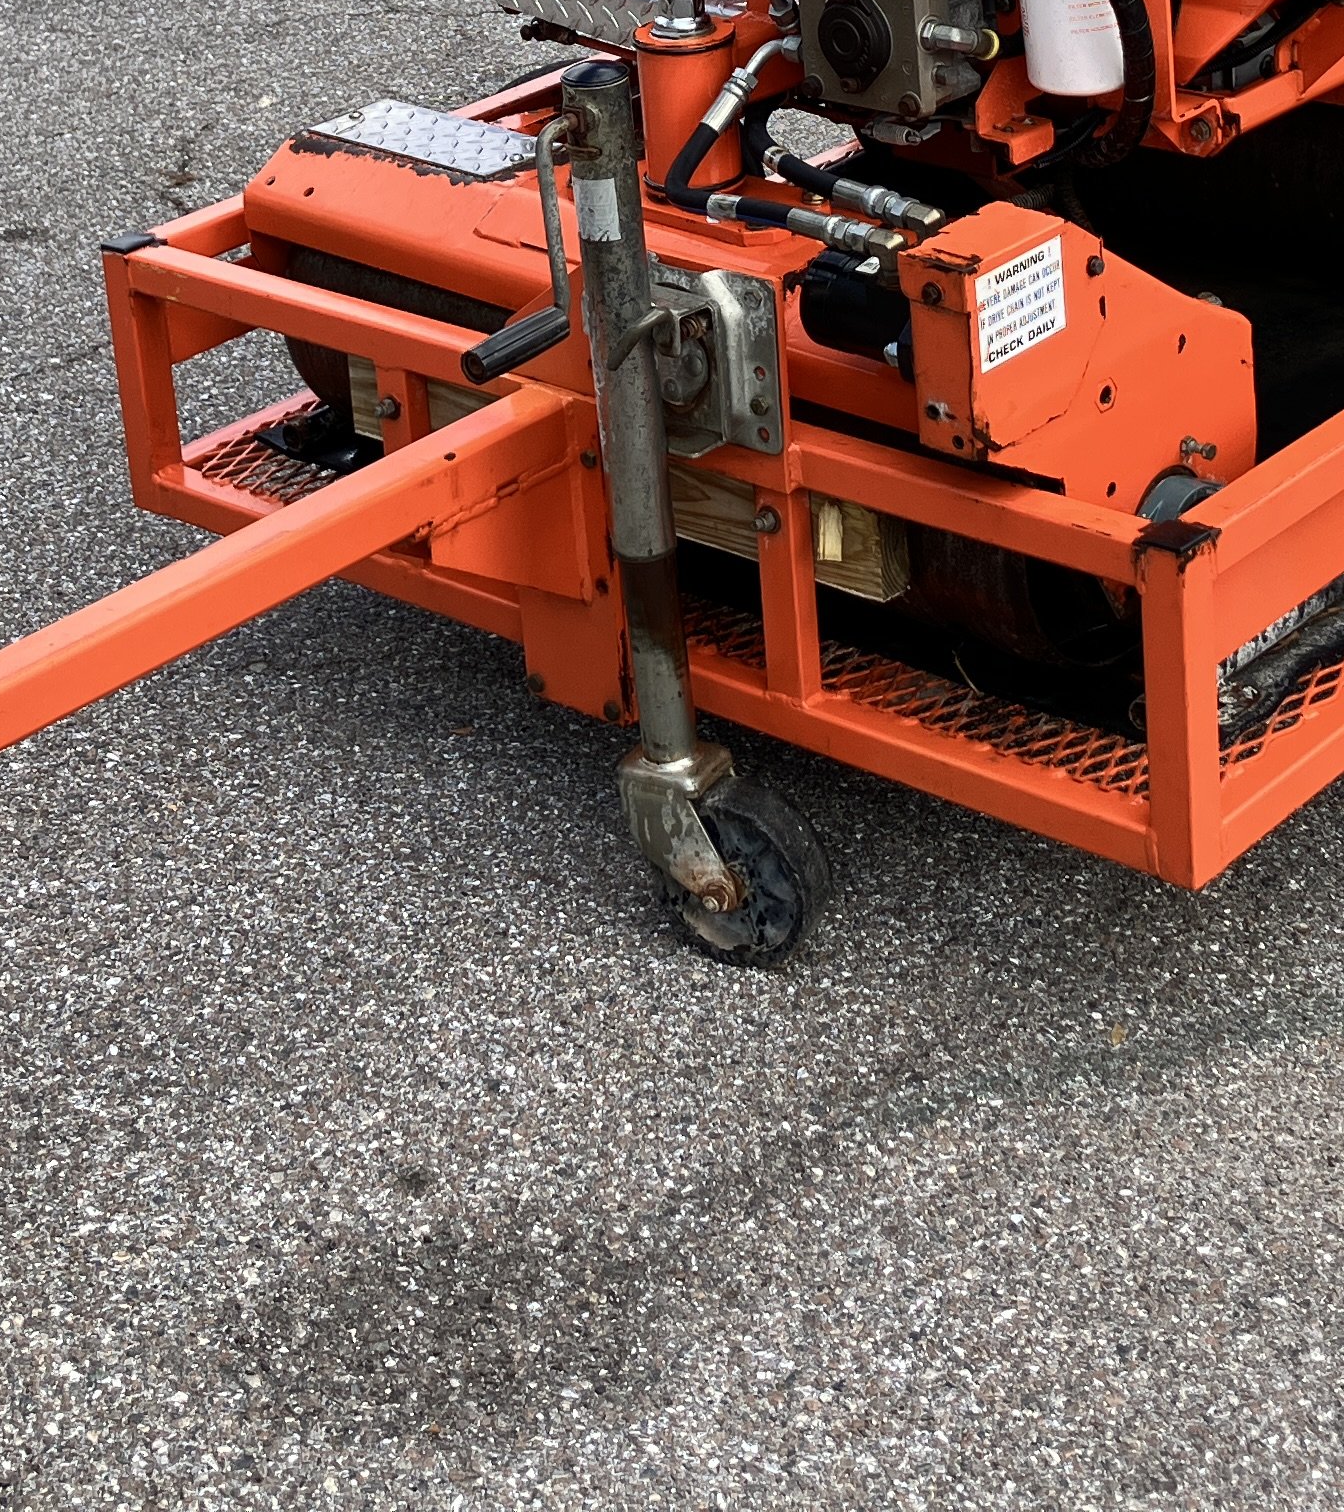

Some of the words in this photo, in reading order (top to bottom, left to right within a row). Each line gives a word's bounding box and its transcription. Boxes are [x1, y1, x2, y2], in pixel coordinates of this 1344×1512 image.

[994, 251, 1045, 285] WARNING
[987, 309, 1005, 326] DRIVE
[1006, 299, 1024, 316] CHAIN
[1025, 294, 1032, 306] IS
[1033, 287, 1045, 301] NOT
[1046, 278, 1061, 294] KEPT
[1002, 278, 1027, 299] DAMAGE
[1028, 272, 1040, 285] CAN
[987, 334, 994, 346] IN
[995, 321, 1017, 339] PROPER
[988, 335, 1024, 363] CHECK
[1028, 317, 1056, 341] DAILY
